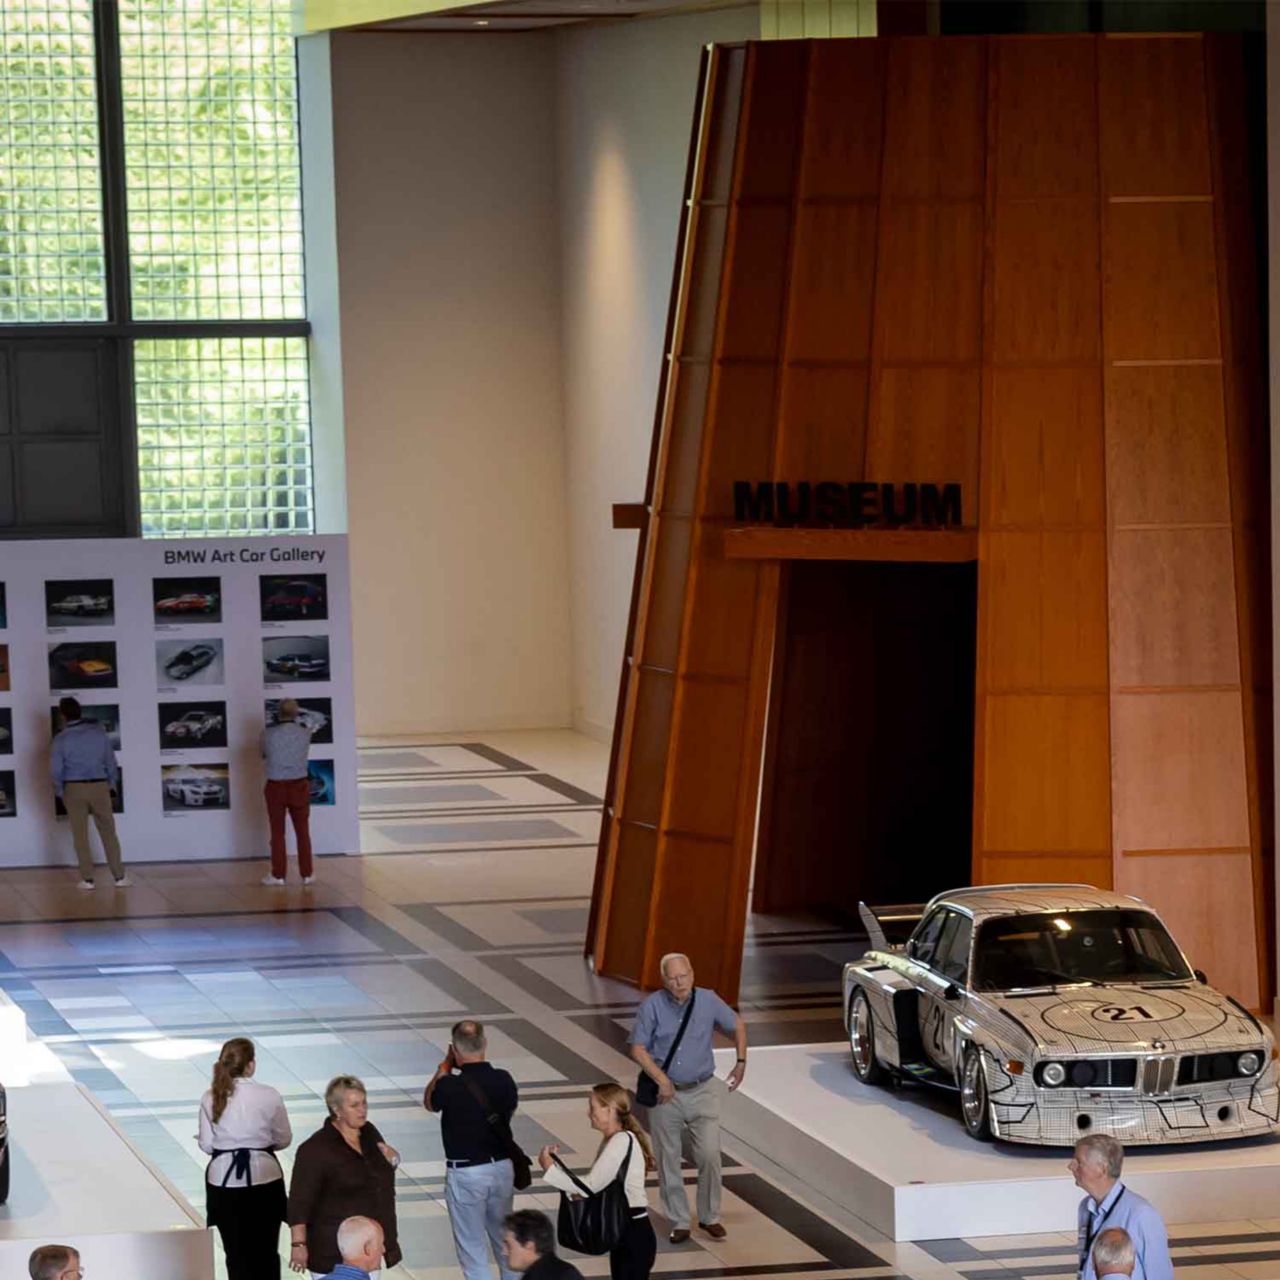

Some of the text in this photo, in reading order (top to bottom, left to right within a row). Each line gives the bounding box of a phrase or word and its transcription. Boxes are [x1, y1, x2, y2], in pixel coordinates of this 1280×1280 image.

[733, 480, 962, 526] MUSEUM
[164, 547, 325, 564] BMW Art Car Gallery
[1102, 1006, 1154, 1020] 21
[933, 1005, 946, 1055] 21
